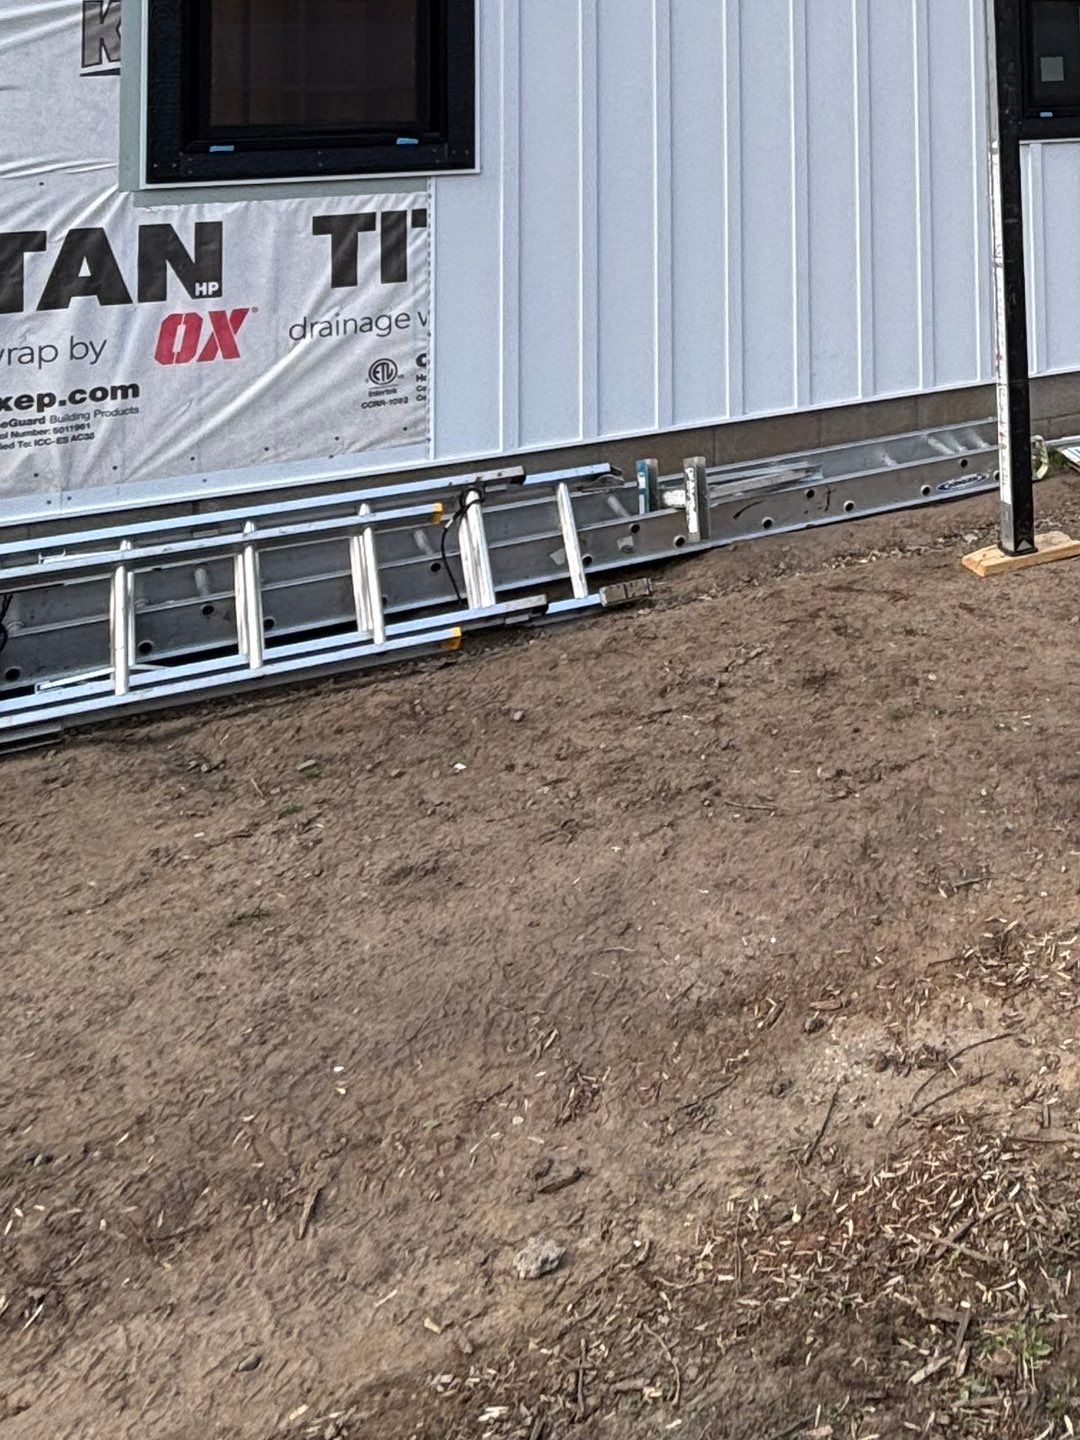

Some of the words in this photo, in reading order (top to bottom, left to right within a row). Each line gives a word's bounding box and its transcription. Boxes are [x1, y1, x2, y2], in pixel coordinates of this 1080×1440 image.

[194, 282, 220, 296] HP
[289, 312, 411, 341] drainage
[69, 335, 107, 363] by
[154, 307, 250, 366] OX
[49, 411, 91, 424] Building
[94, 406, 140, 418] Products
[11, 428, 51, 438] Number:
